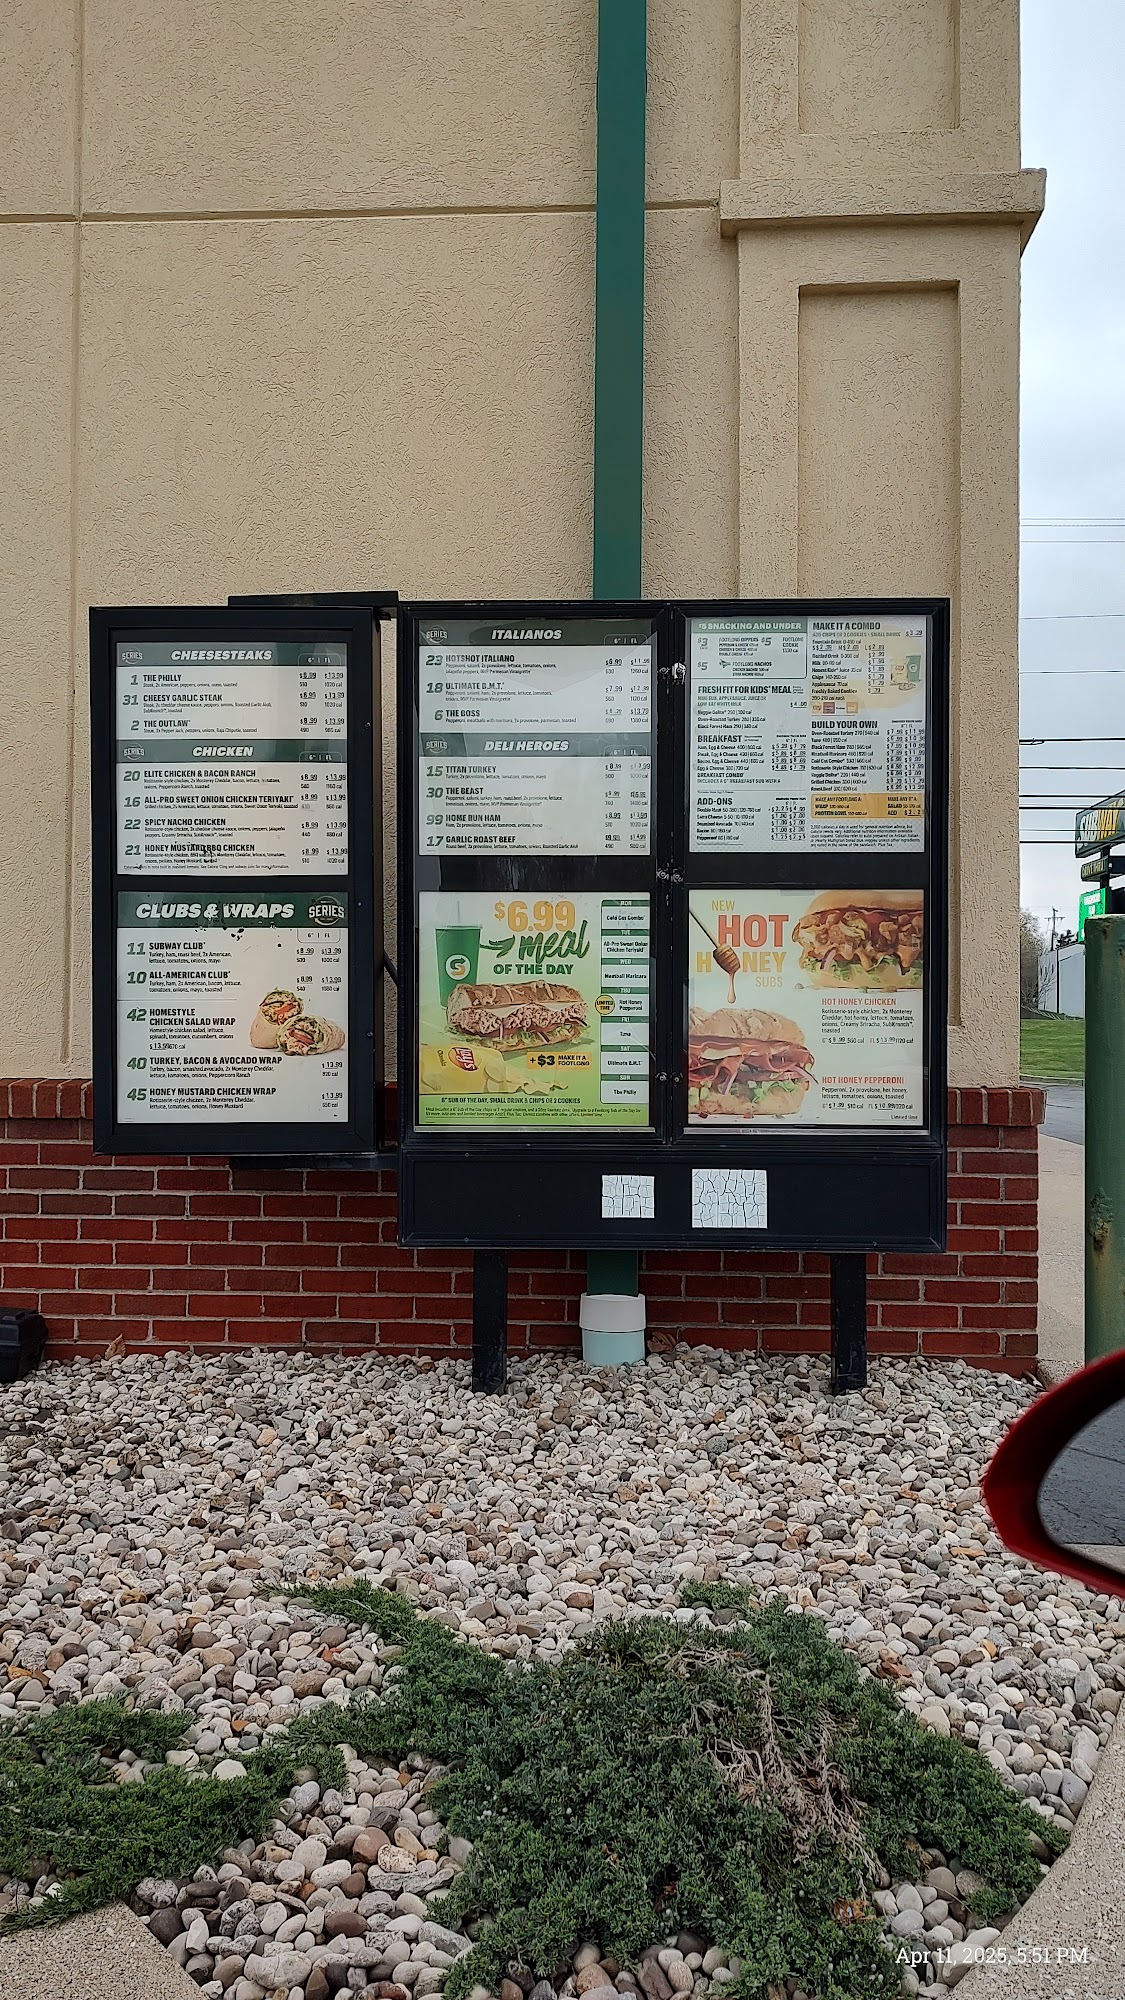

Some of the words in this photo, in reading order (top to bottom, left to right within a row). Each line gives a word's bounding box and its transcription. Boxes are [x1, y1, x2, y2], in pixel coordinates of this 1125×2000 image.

[492, 630, 562, 639] ITALIANOS
[122, 652, 142, 660] SERIES
[171, 650, 272, 660] CHEESESTEAKS
[426, 655, 443, 665] 23
[131, 675, 138, 685] 1
[426, 683, 443, 693] 18
[123, 695, 138, 705] 31
[435, 710, 443, 720] 6
[131, 720, 139, 730] 2
[484, 742, 514, 751] DELI
[516, 741, 569, 751] HEROES
[124, 748, 145, 756] SERIES
[192, 747, 253, 757] CHICKEN
[124, 771, 140, 781] 20
[426, 766, 443, 776] 15
[426, 787, 443, 798] 30
[124, 797, 140, 807] 16
[124, 819, 141, 829] 22
[426, 815, 443, 825] 99
[426, 836, 443, 846] 17
[125, 845, 141, 855] 21
[712, 900, 735, 911] NEW
[136, 904, 201, 918] CLUBS
[204, 904, 219, 918] &
[223, 904, 294, 918] WRAPS
[309, 905, 344, 918] SERIES
[495, 901, 575, 932] $6.99
[718, 915, 788, 947] HOT
[519, 920, 590, 964] meal
[127, 943, 145, 955] 11
[697, 952, 786, 972] HNEY
[493, 964, 512, 974] OF
[515, 964, 542, 974] THE
[546, 964, 573, 974] DAY
[127, 972, 147, 984] 10
[756, 977, 783, 987] SUBS
[127, 1009, 147, 1021] 42
[127, 1057, 147, 1069] 40
[150, 1057, 181, 1065] TURKEY,
[538, 1054, 555, 1067] $3
[127, 1088, 147, 1100] 45
